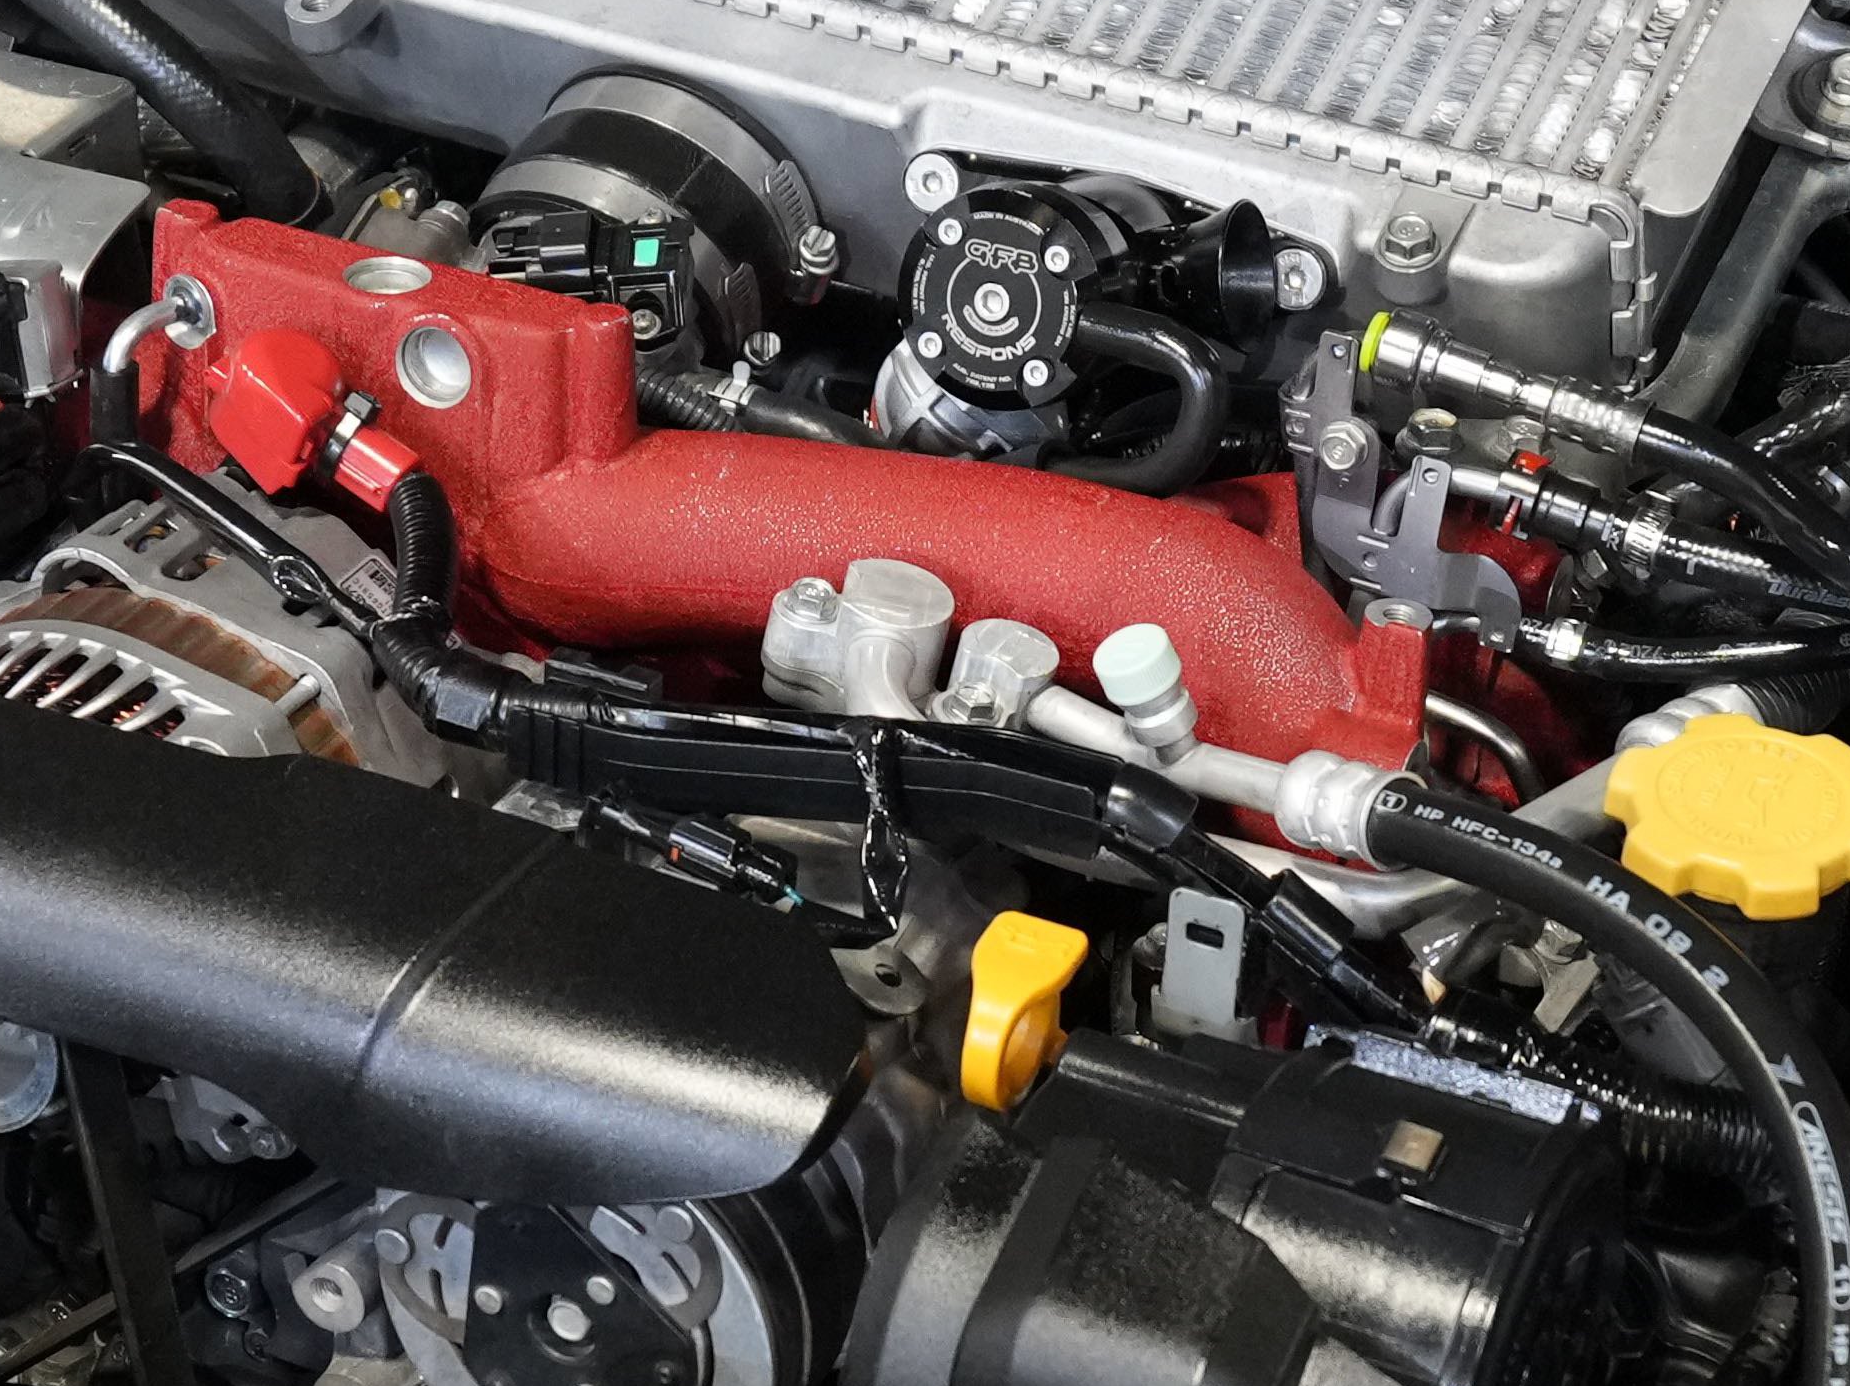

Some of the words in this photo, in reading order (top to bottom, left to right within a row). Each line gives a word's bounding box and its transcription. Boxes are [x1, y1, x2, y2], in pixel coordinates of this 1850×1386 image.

[964, 238, 1039, 275] GFB
[941, 313, 1037, 362] RESPONS
[969, 371, 998, 383] PATENT
[1413, 803, 1446, 822] HP
[1452, 814, 1564, 870] HFC-134a
[1586, 875, 1631, 913] HA
[1831, 1323, 1850, 1366] HP
